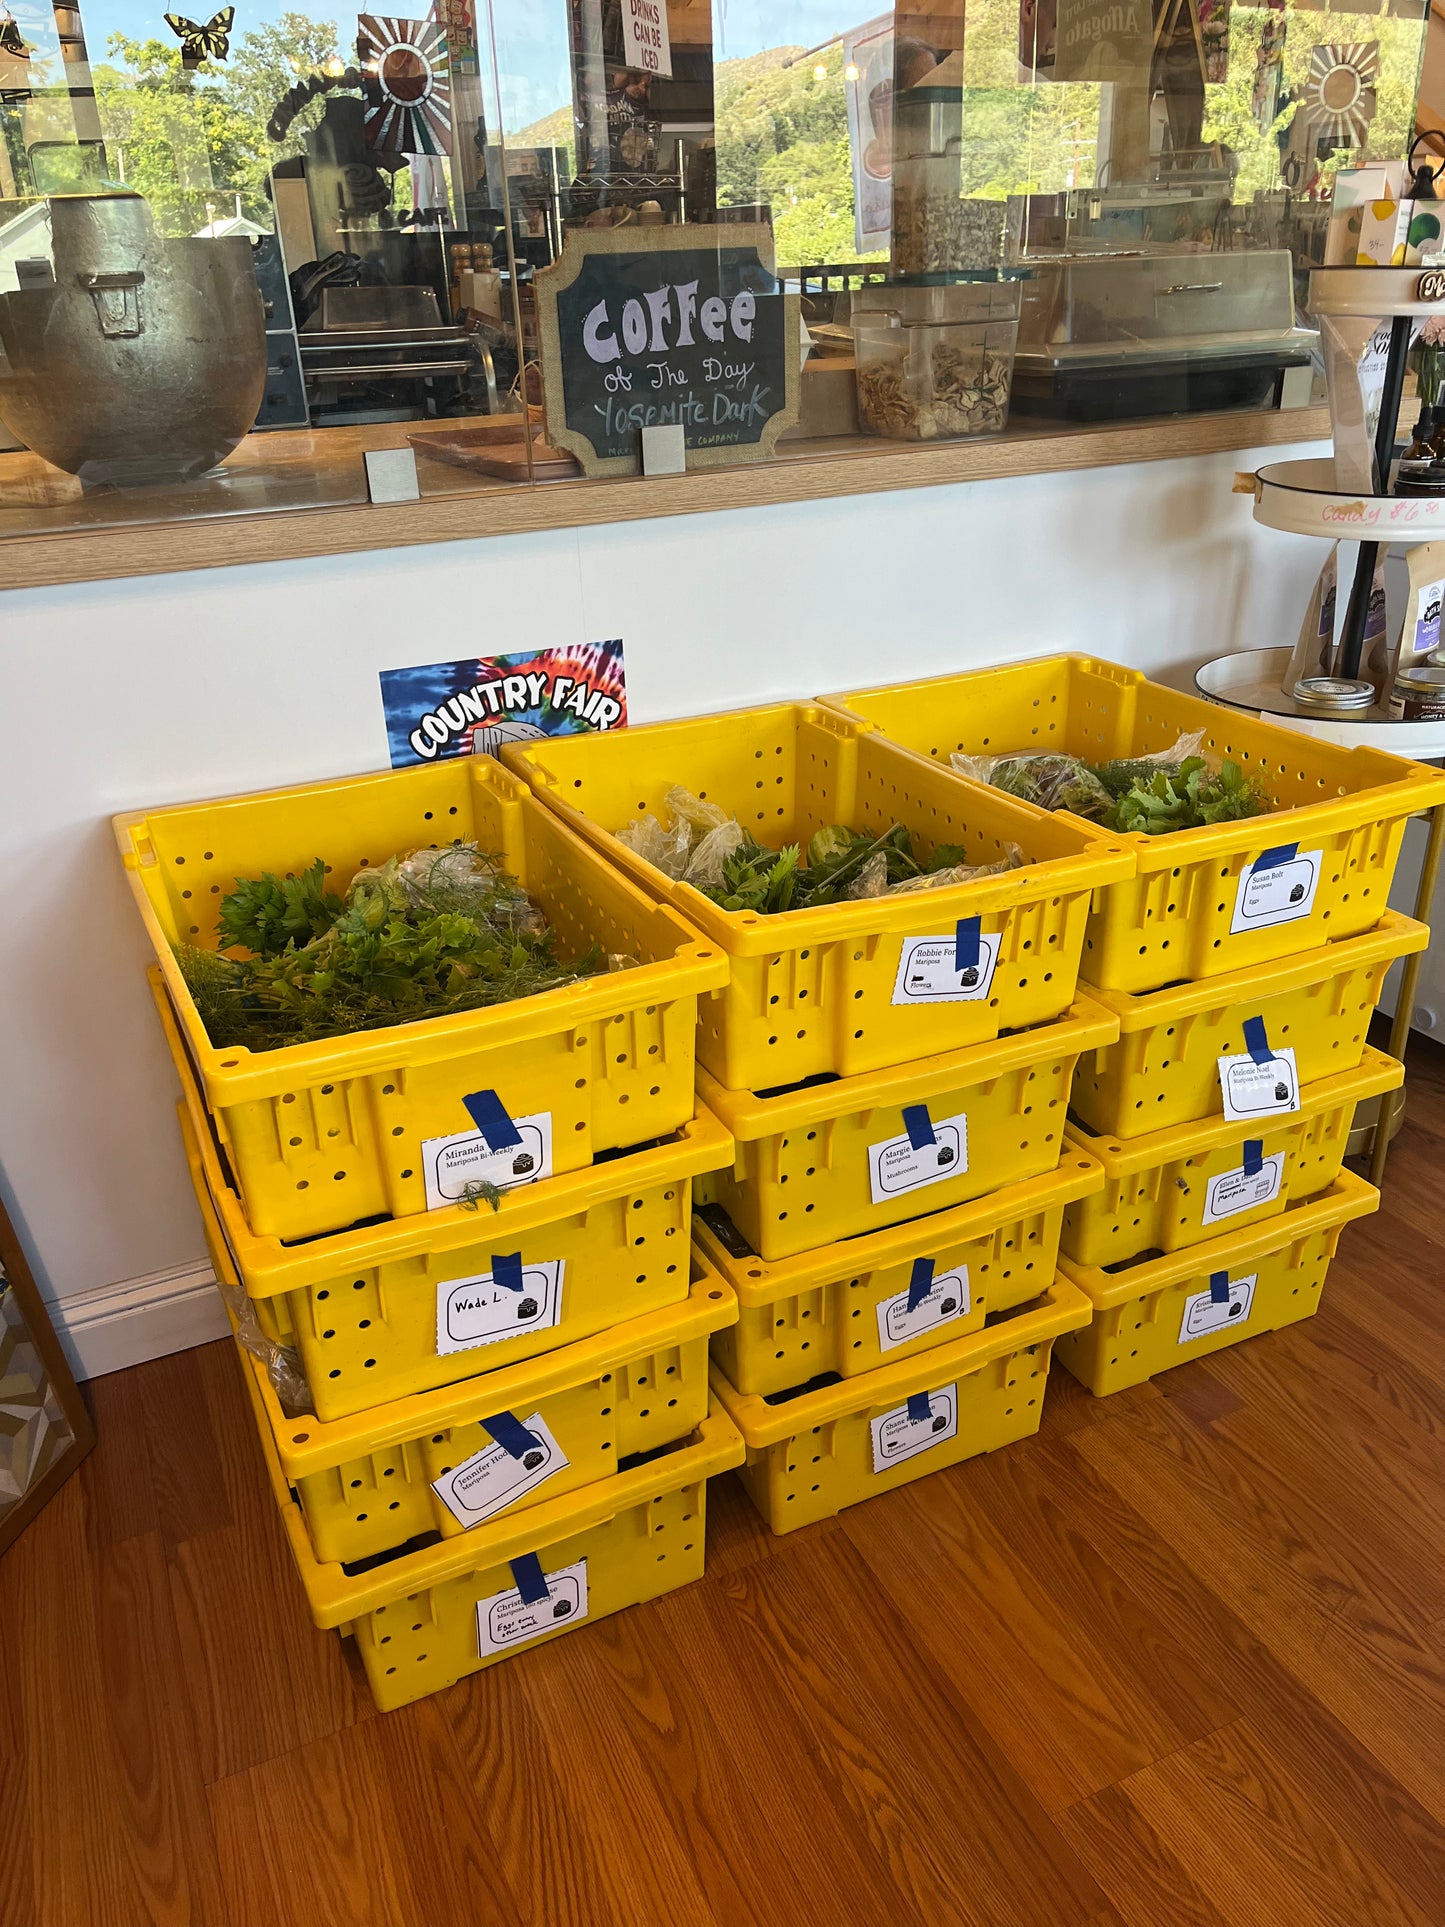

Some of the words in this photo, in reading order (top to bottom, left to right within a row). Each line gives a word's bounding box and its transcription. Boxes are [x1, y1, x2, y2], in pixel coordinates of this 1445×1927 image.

[631, 0, 660, 25] DRINKS
[634, 21, 651, 45] CAN
[651, 27, 662, 48] BE
[641, 48, 659, 70] ICED
[604, 366, 632, 392] of
[646, 361, 688, 389] The
[702, 356, 755, 391] Day
[698, 430, 740, 446] COMPANY
[410, 674, 547, 758] COUNTRY
[550, 677, 622, 733] FAIR
[1251, 882, 1272, 891] Mariposa
[1252, 874, 1270, 884] Susan
[917, 948, 942, 957] Robbie
[943, 948, 956, 956] For
[915, 958, 940, 966] Mariposa
[445, 1144, 485, 1161] Miranda
[446, 1155, 479, 1169] Mariposa
[480, 1146, 514, 1161] Bi-Weekly
[885, 1146, 911, 1160] Margie
[885, 1154, 911, 1166] Mariposa
[886, 1165, 918, 1180] Mushrooms
[455, 1298, 487, 1313] Wade
[892, 1303, 907, 1314] Han
[886, 1424, 909, 1437] Mariposa
[458, 1462, 491, 1487] Jennifer
[491, 1449, 509, 1465] Hod
[462, 1471, 490, 1491] Mariposa
[497, 1606, 525, 1619] Mariposa
